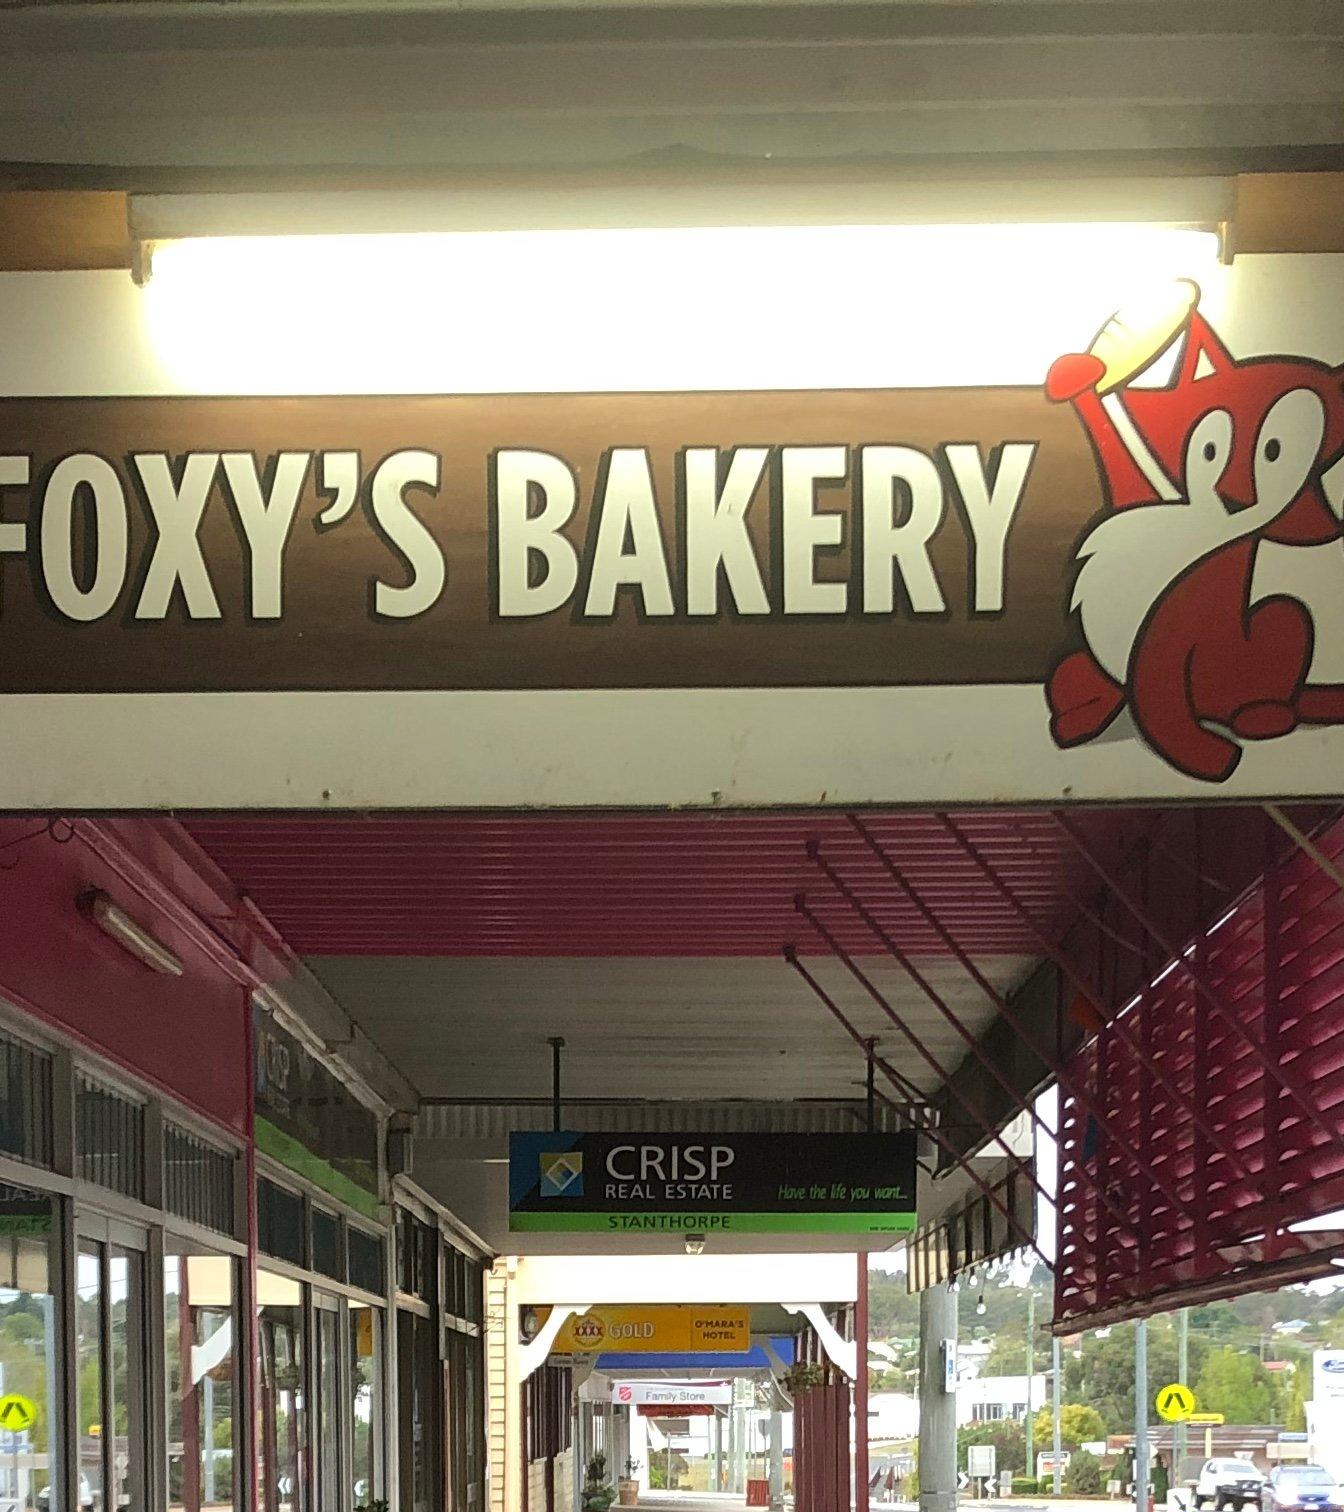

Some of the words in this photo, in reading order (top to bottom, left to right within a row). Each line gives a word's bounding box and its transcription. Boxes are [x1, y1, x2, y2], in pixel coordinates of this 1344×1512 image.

[497, 442, 1038, 618] BAKERY
[605, 1144, 735, 1181] CRISP
[605, 1184, 655, 1200] REAL
[665, 1184, 733, 1200] ESTATE
[778, 1184, 805, 1200] Have
[810, 1184, 826, 1200] the
[830, 1182, 846, 1200] life
[850, 1186, 870, 1203] you
[608, 1215, 731, 1229] STANTHORPE
[574, 1325, 604, 1337] XXXX
[609, 1321, 656, 1340] GOLD
[694, 1319, 744, 1329] O'MARA'S
[702, 1331, 736, 1340] HOTEL
[645, 1391, 676, 1402] Family
[679, 1391, 706, 1401] Store
